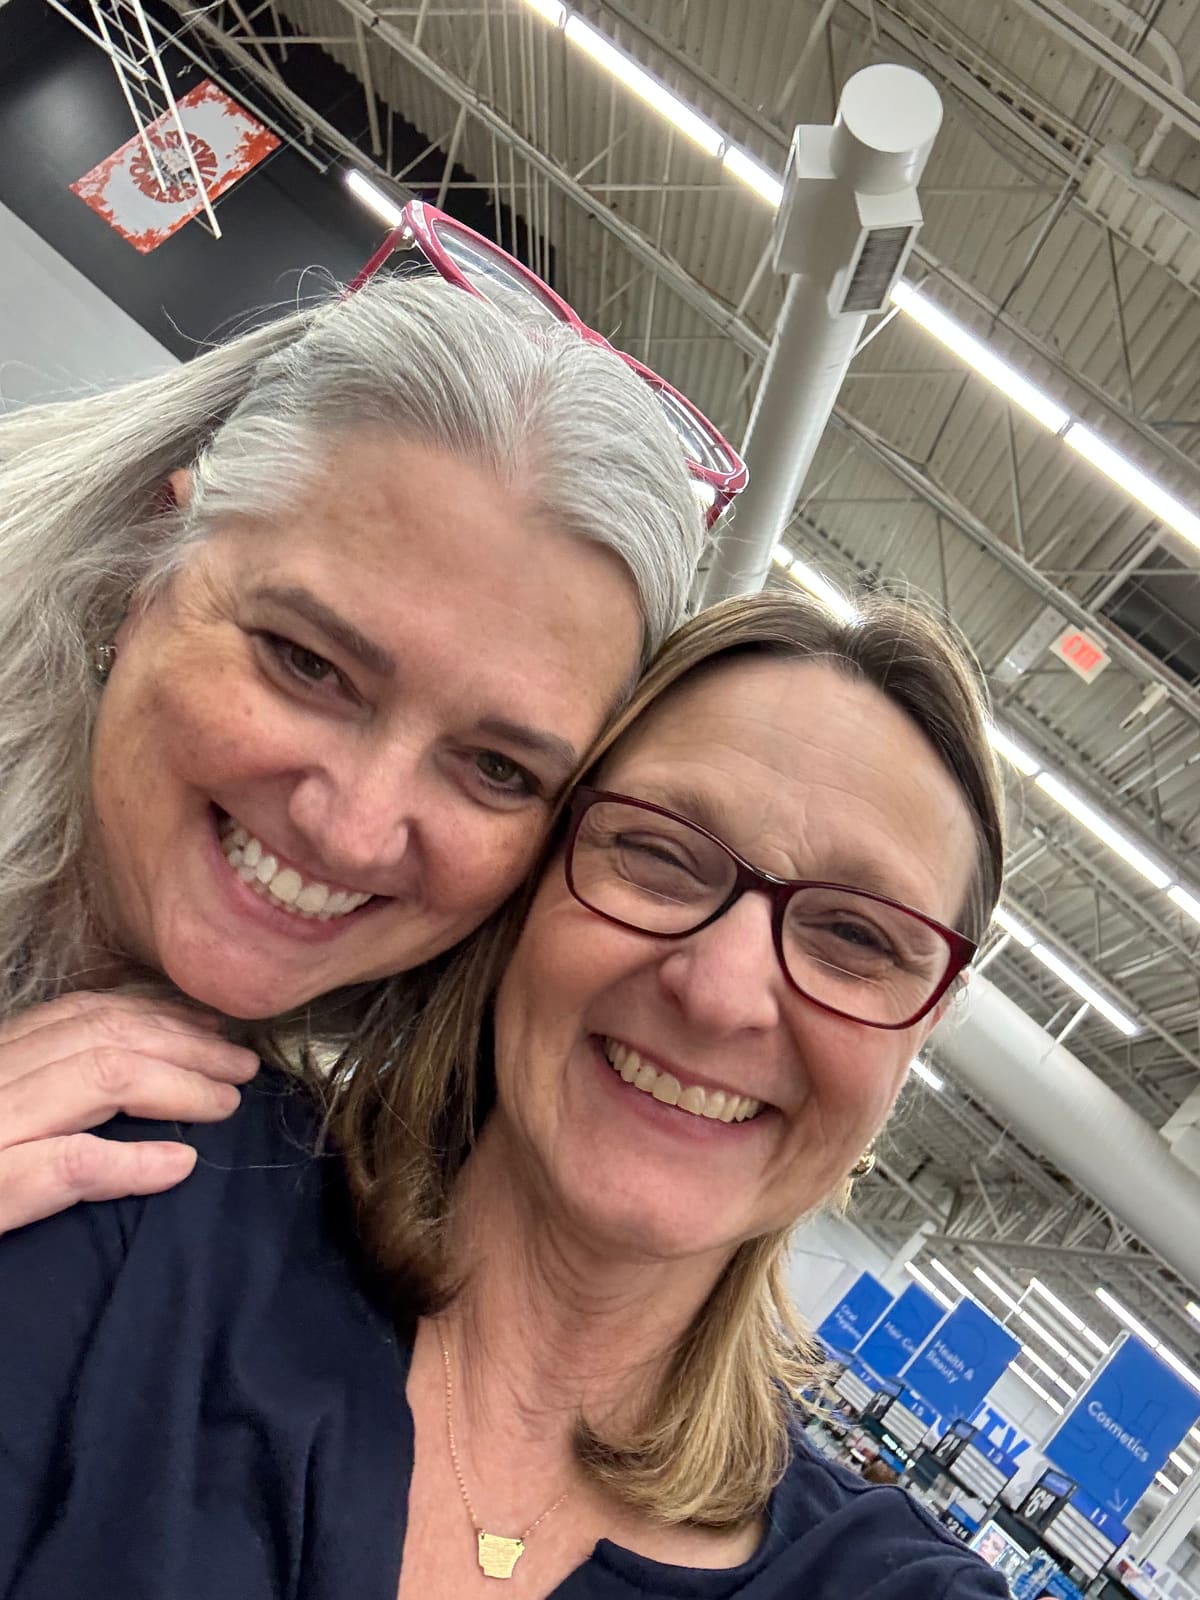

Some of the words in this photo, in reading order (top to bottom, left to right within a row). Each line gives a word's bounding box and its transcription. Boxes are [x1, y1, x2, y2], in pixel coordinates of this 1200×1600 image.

[883, 1321, 901, 1340] Hair
[925, 1350, 959, 1385] Beauty
[934, 1339, 965, 1373] Health
[963, 1367, 975, 1382] &
[1087, 1400, 1150, 1463] Cosmetics
[1089, 1506, 1109, 1527] 11
